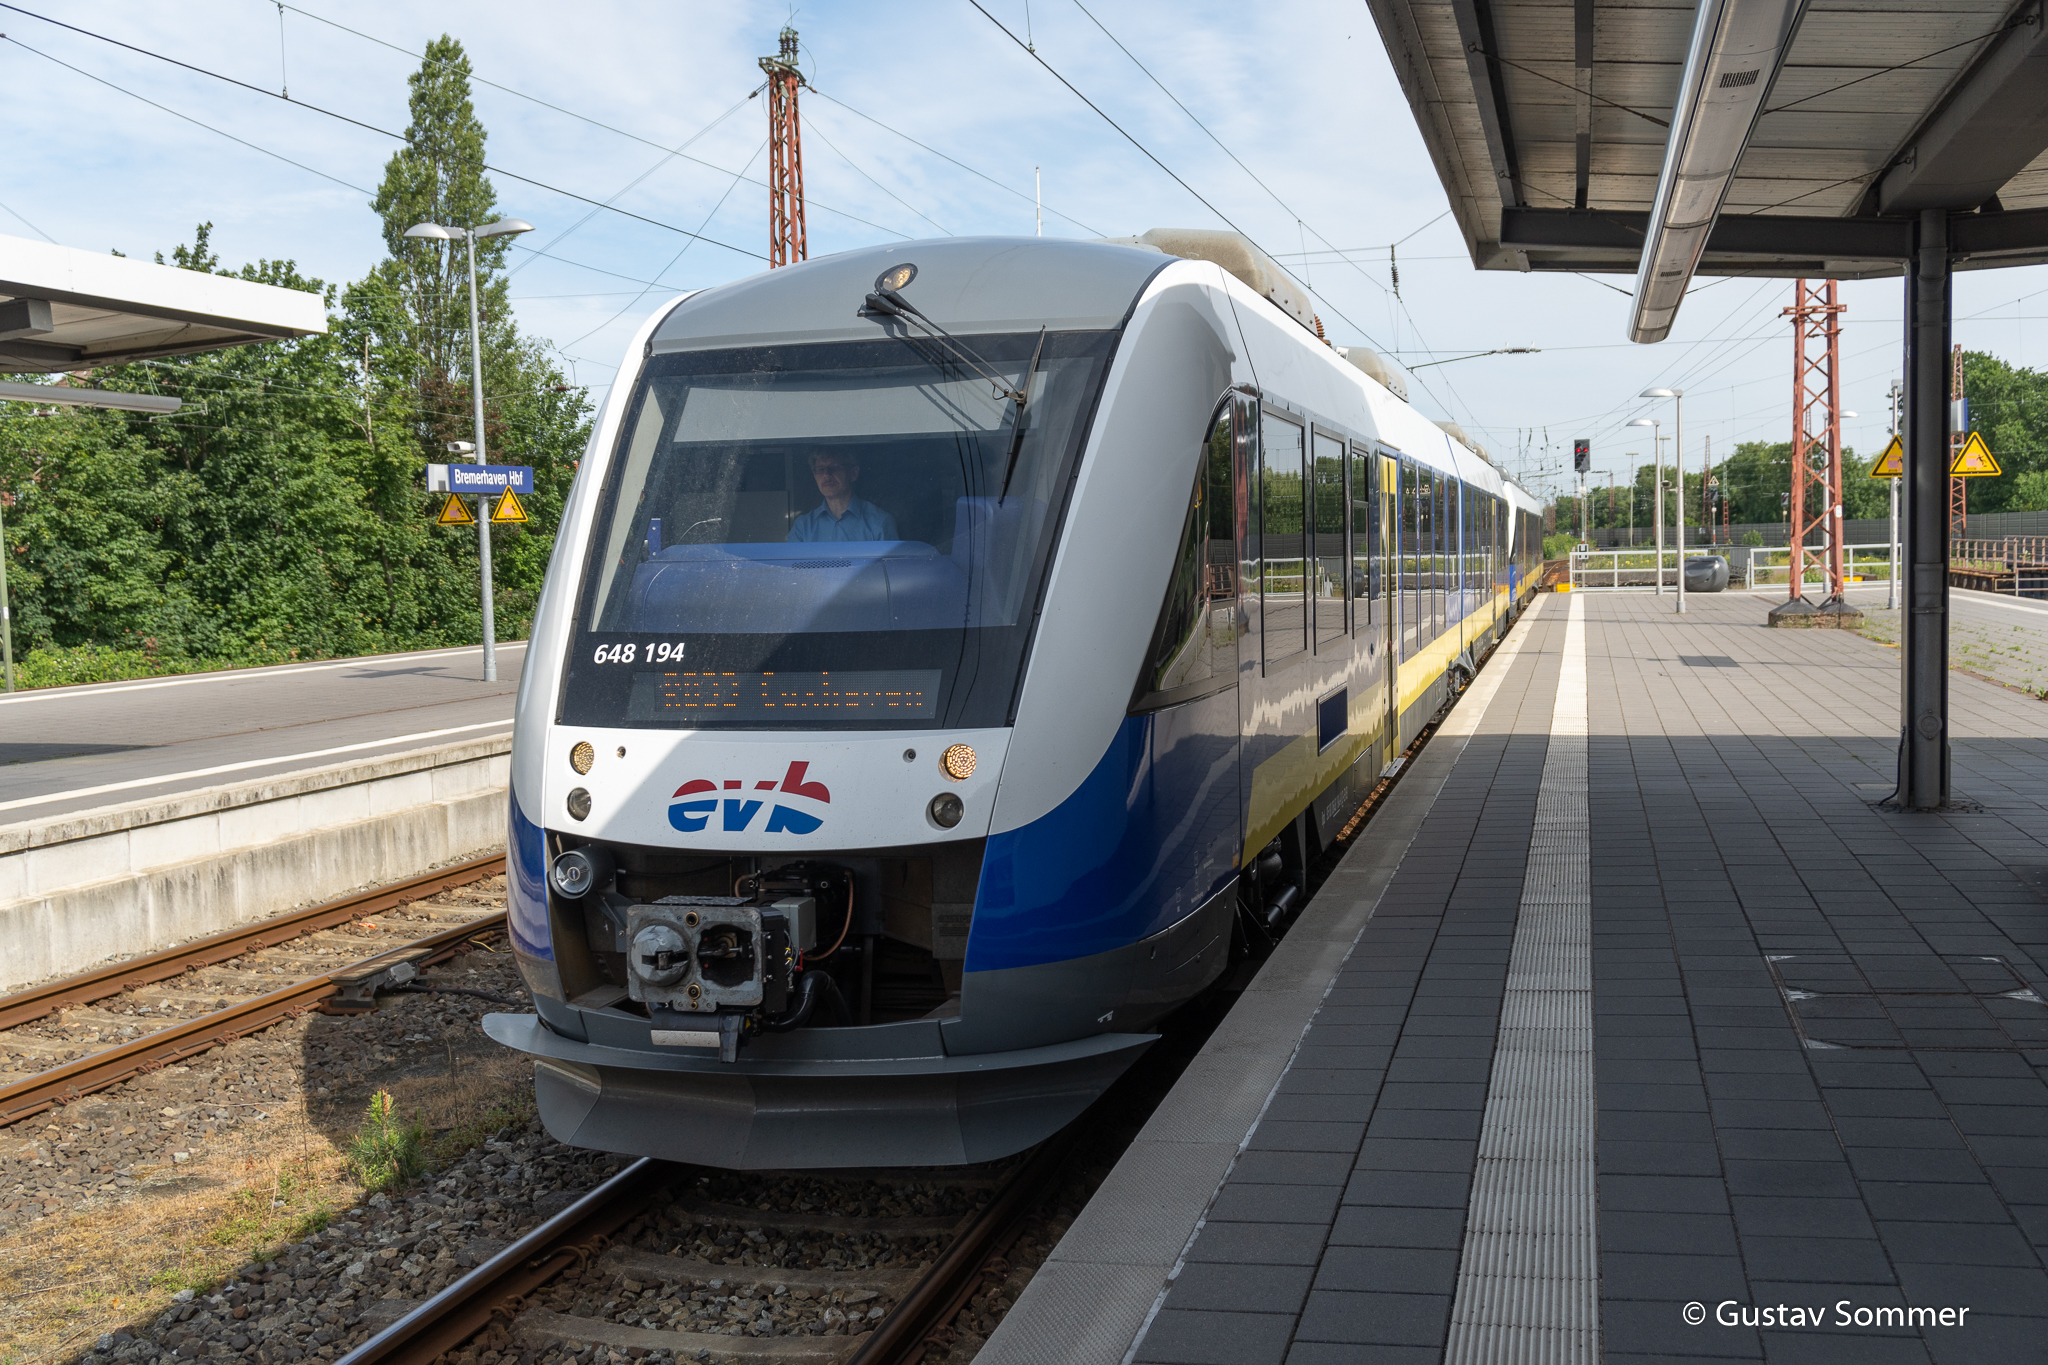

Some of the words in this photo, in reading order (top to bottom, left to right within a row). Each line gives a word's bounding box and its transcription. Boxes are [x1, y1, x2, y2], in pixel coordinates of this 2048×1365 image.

[454, 468, 508, 485] Bremerhaven
[508, 470, 524, 486] Hbf
[593, 643, 637, 664] 648
[645, 642, 685, 663] 194
[668, 760, 831, 835] evb
